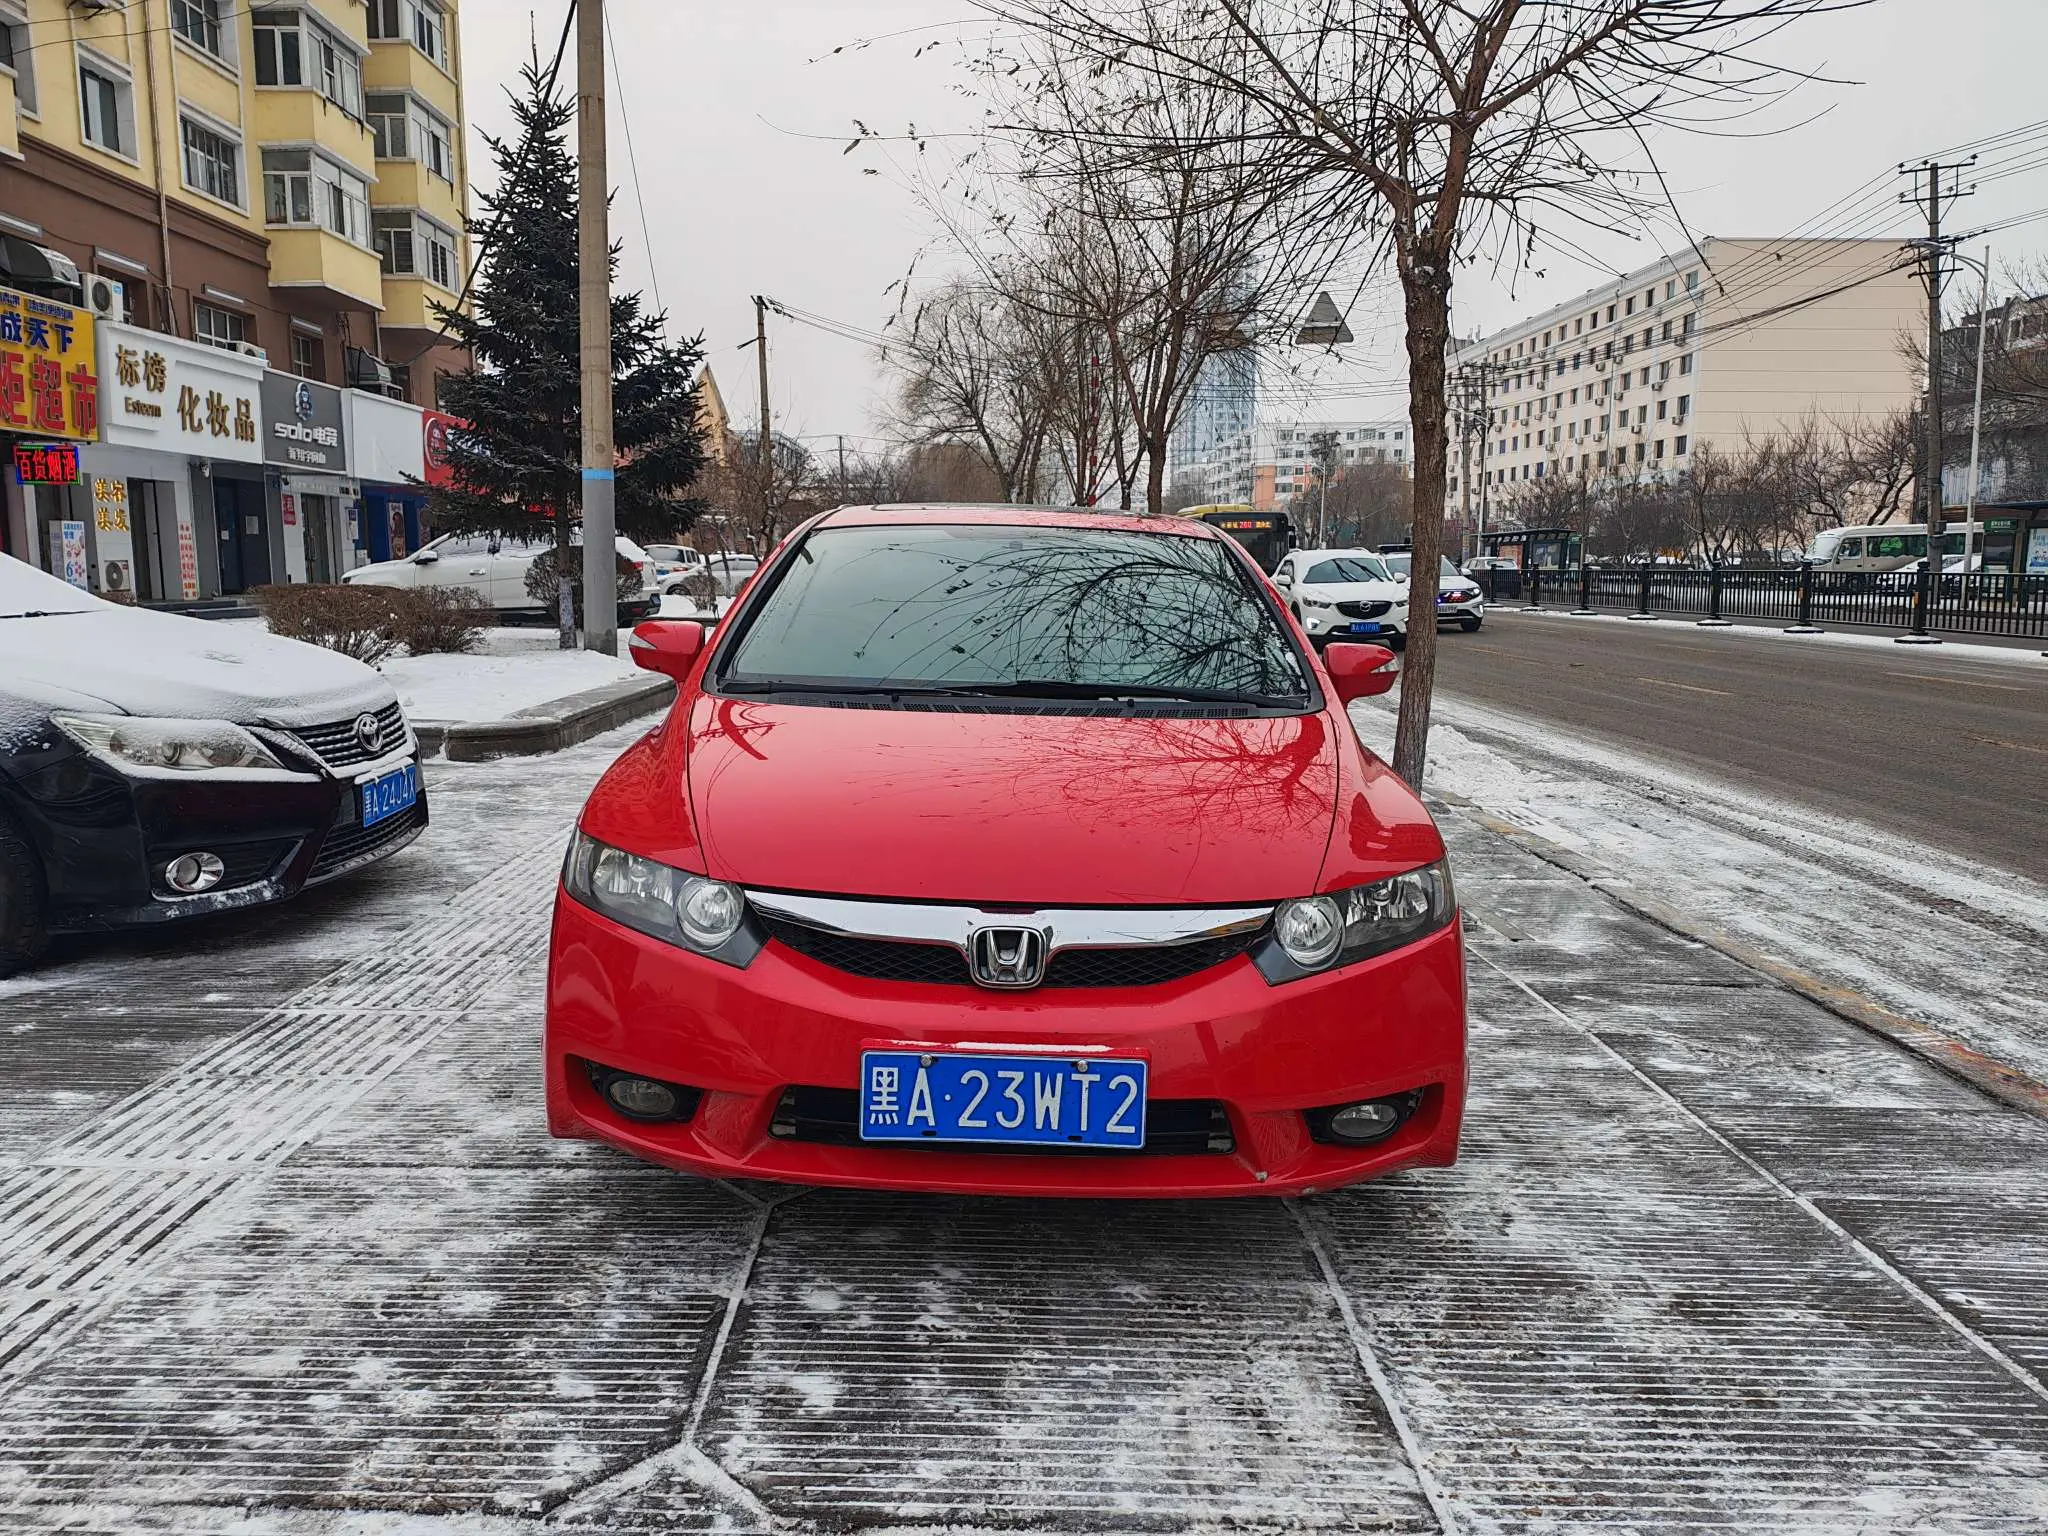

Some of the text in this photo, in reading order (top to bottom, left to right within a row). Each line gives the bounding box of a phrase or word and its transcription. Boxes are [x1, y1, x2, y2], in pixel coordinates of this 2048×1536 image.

[116, 344, 167, 392] 标榜
[177, 384, 255, 442] 化妆品
[17, 451, 77, 481] 百货烟酒
[95, 478, 126, 503] 美容
[97, 507, 129, 533] 美发
[869, 1066, 1137, 1134] 黑A·23WT2
